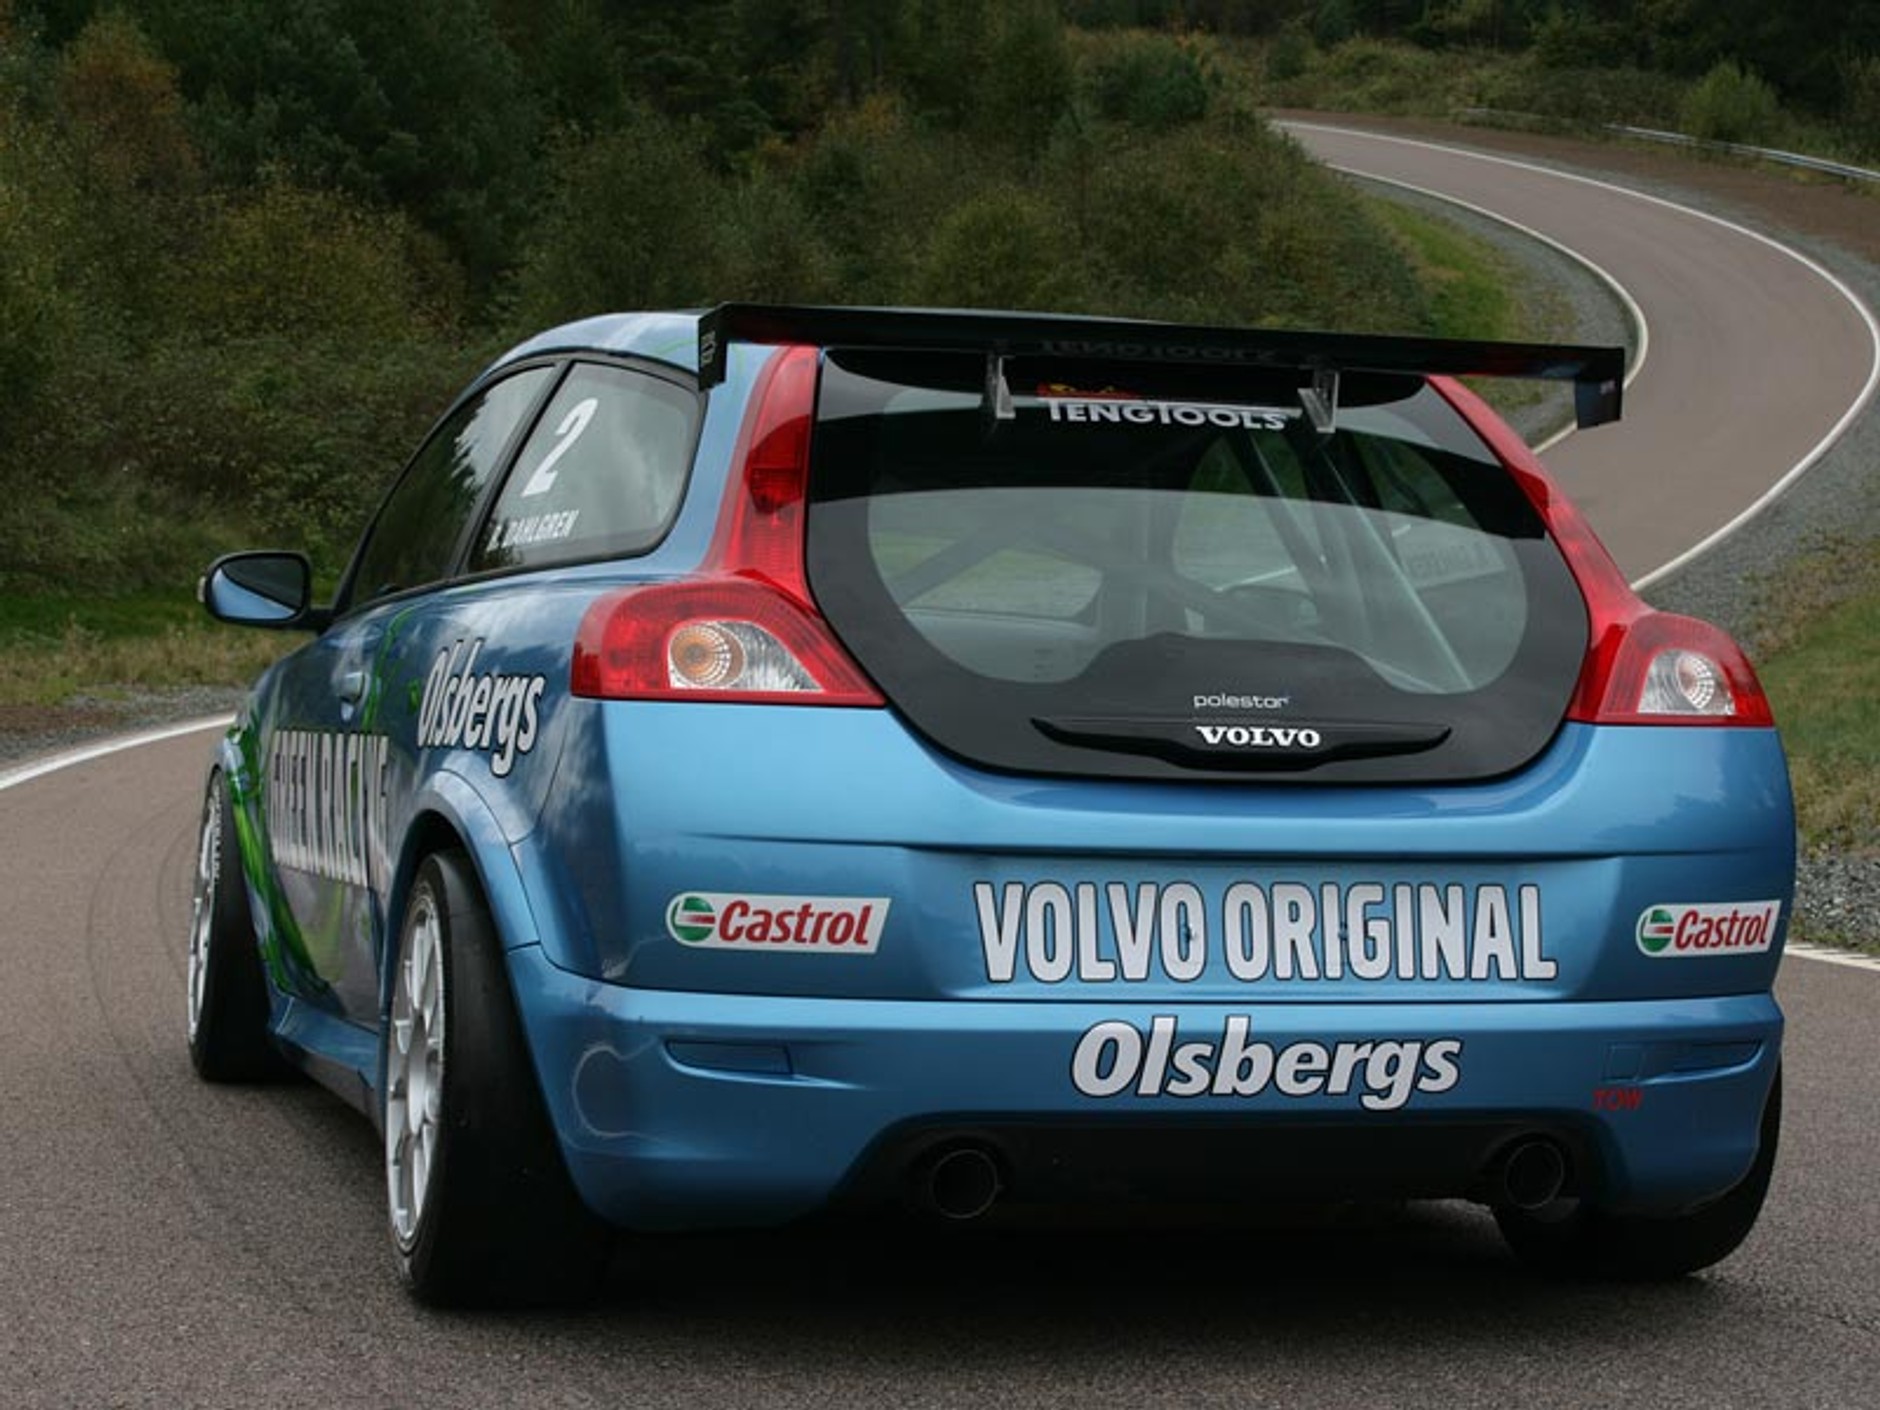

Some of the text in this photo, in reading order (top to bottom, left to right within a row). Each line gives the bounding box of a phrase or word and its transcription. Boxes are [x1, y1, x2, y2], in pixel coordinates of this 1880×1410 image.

[1050, 400, 1287, 430] TENGTOOLS
[522, 397, 598, 498] 2
[417, 637, 547, 778] Olsbergs
[1193, 692, 1290, 710] polestar
[1195, 725, 1322, 747] VOLVO
[269, 730, 320, 876] GREEN
[320, 732, 393, 896] RACING
[718, 900, 873, 945] Castrol
[973, 881, 1558, 983] VOLVO ORIGINAL
[1674, 907, 1772, 949] Castrol
[1071, 1014, 1464, 1111] Olsbergs
[1592, 1088, 1643, 1111] TOW
